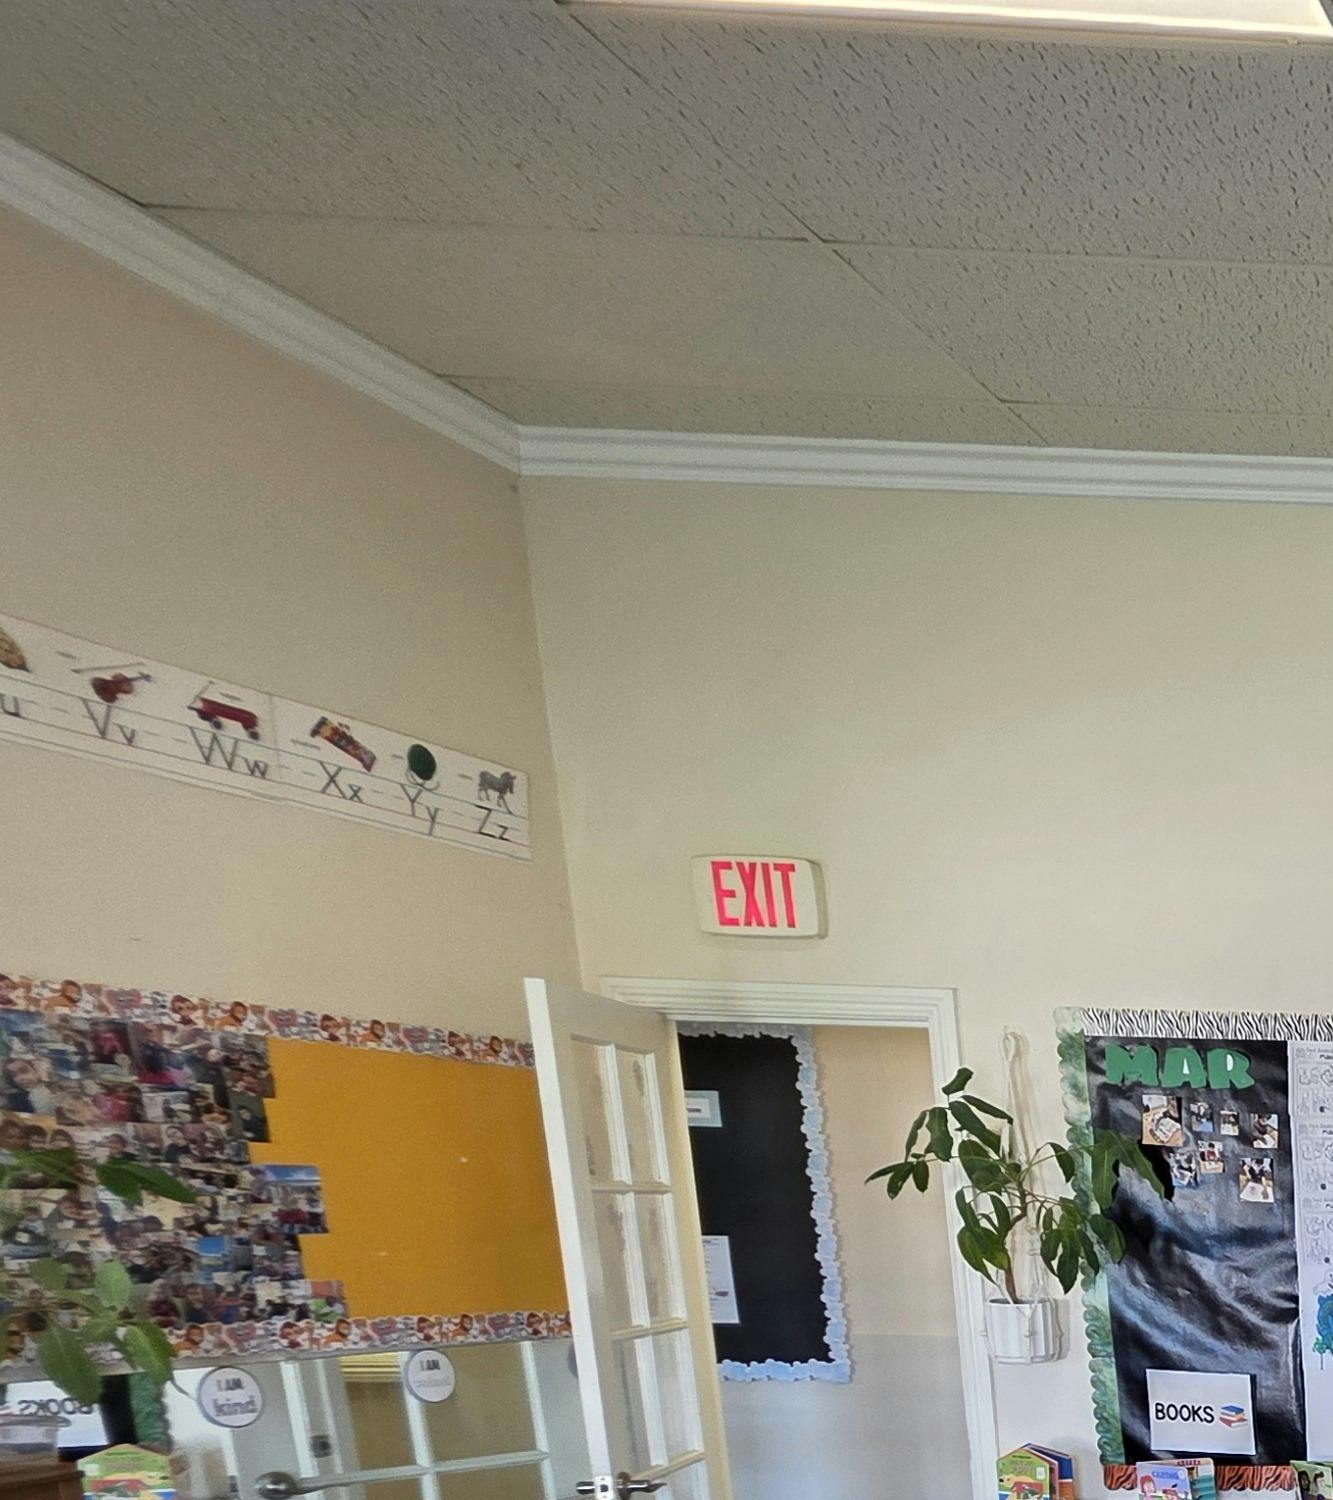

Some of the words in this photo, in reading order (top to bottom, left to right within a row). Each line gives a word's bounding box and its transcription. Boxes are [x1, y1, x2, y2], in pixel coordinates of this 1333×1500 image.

[711, 860, 796, 929] EXIT
[1105, 1044, 1255, 1089] MAR
[1155, 1402, 1215, 1425] BOOKS
